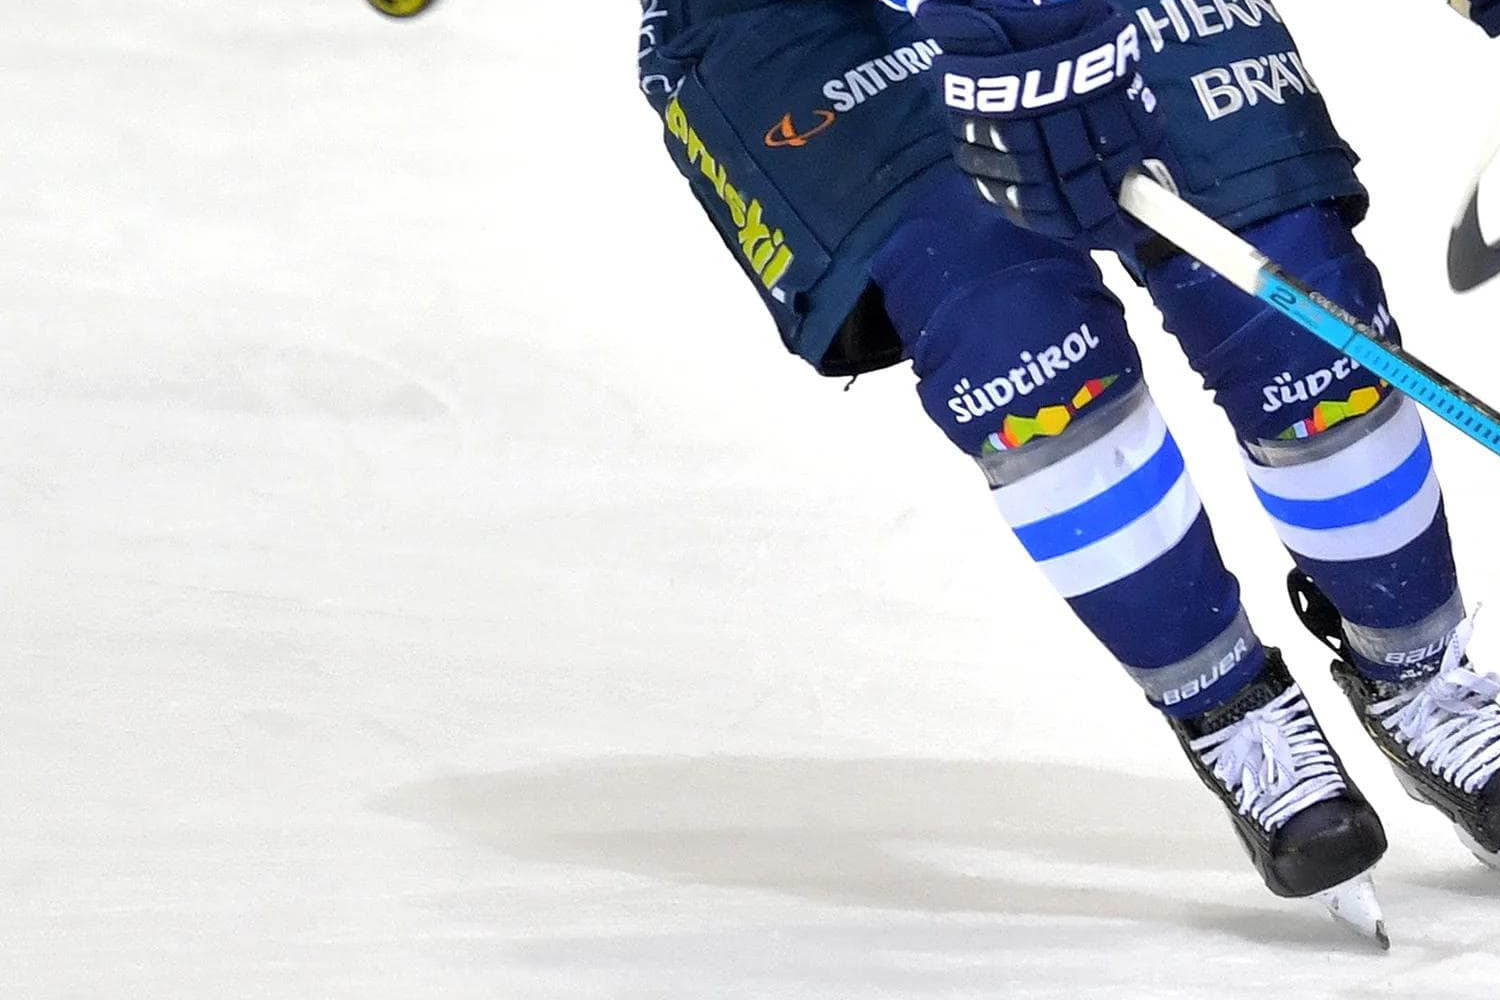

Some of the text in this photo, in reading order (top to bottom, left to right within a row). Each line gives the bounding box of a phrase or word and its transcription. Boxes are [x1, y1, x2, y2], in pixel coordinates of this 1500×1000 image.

[823, 39, 943, 112] SATURN
[945, 23, 1141, 113] BAUER
[1162, 636, 1248, 706] BAUER
